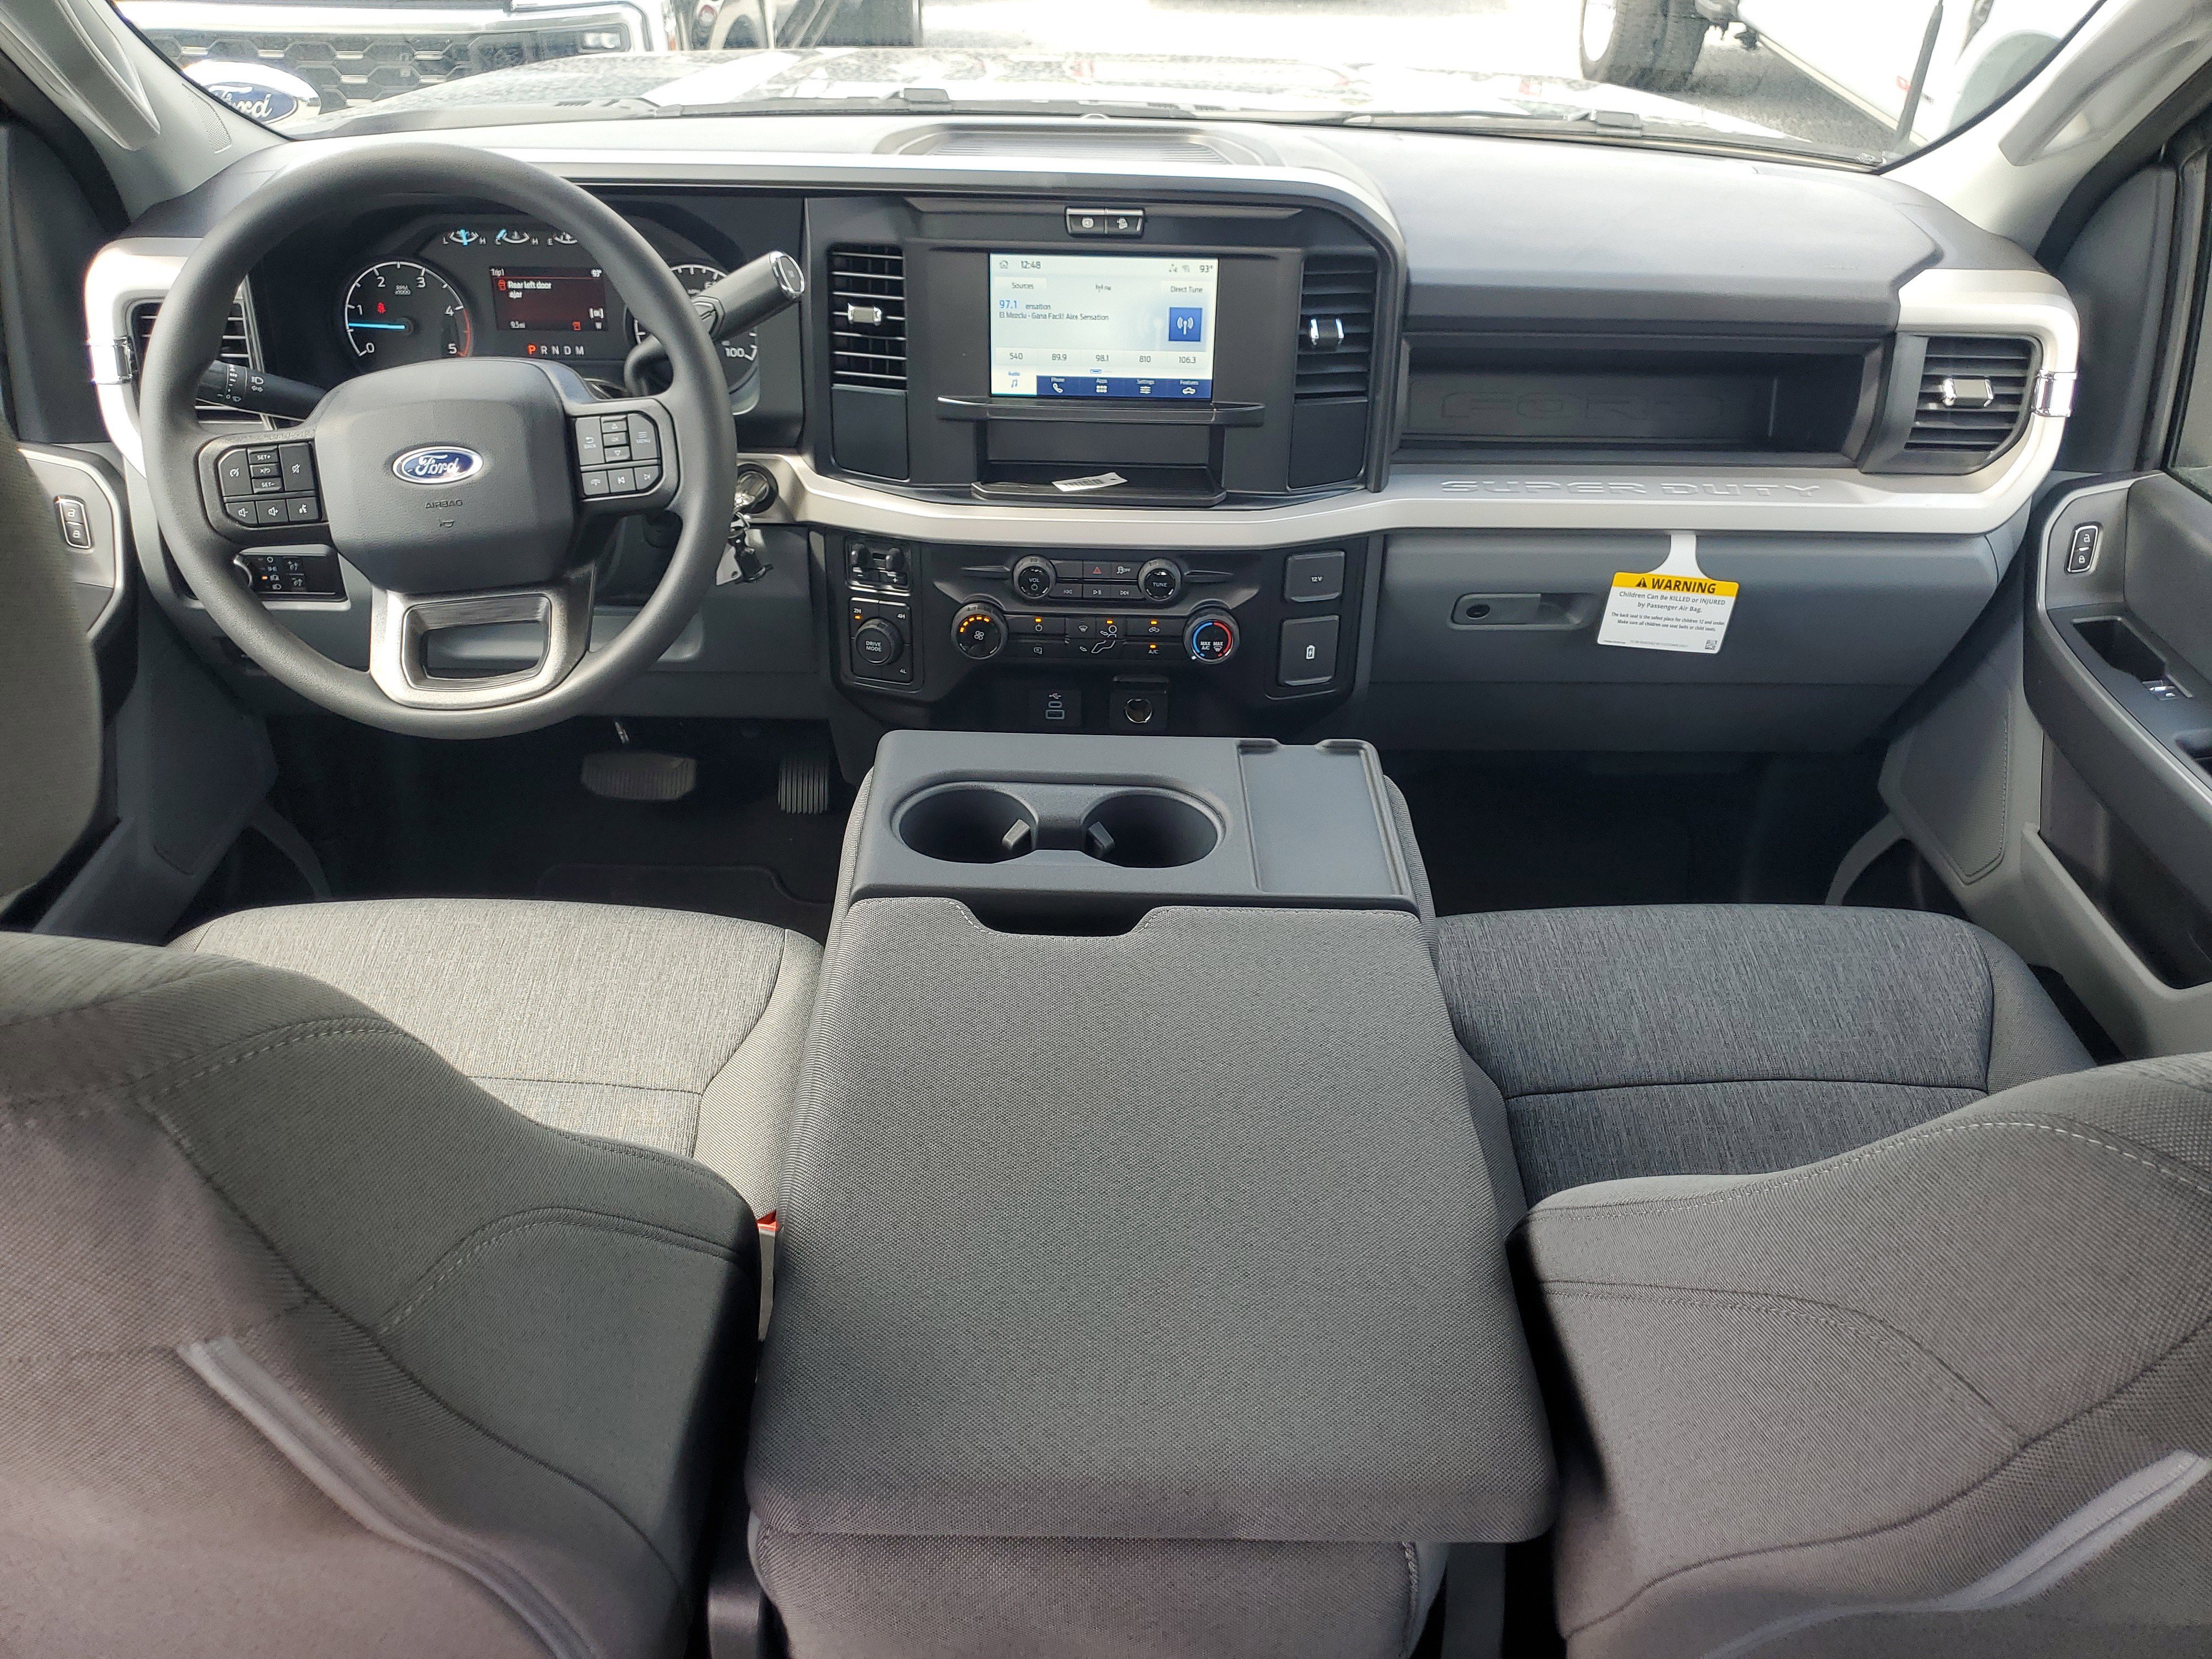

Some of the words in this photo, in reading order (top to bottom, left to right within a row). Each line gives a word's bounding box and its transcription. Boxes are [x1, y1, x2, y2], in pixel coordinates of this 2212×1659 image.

[208, 85, 273, 119] Frd
[377, 276, 386, 287] 2
[416, 277, 426, 288] 3
[507, 280, 523, 289] Rear
[523, 280, 536, 289] left
[536, 280, 551, 289] door
[357, 305, 363, 315] 1
[1000, 300, 1017, 309] 97.1
[445, 305, 454, 316] 4
[366, 342, 375, 353] 0
[448, 343, 457, 354] 5
[527, 344, 536, 354] P
[540, 346, 548, 355] R
[551, 346, 560, 355] N
[563, 346, 571, 355] D
[575, 346, 584, 355] M
[725, 347, 744, 357] 100
[415, 454, 460, 476] Ford
[1441, 480, 1646, 494] SUPER
[1661, 483, 1820, 498] DUTY
[425, 500, 463, 509] AIRBAG
[1652, 578, 1716, 594] WARNING
[1646, 602, 1678, 611] Passenger
